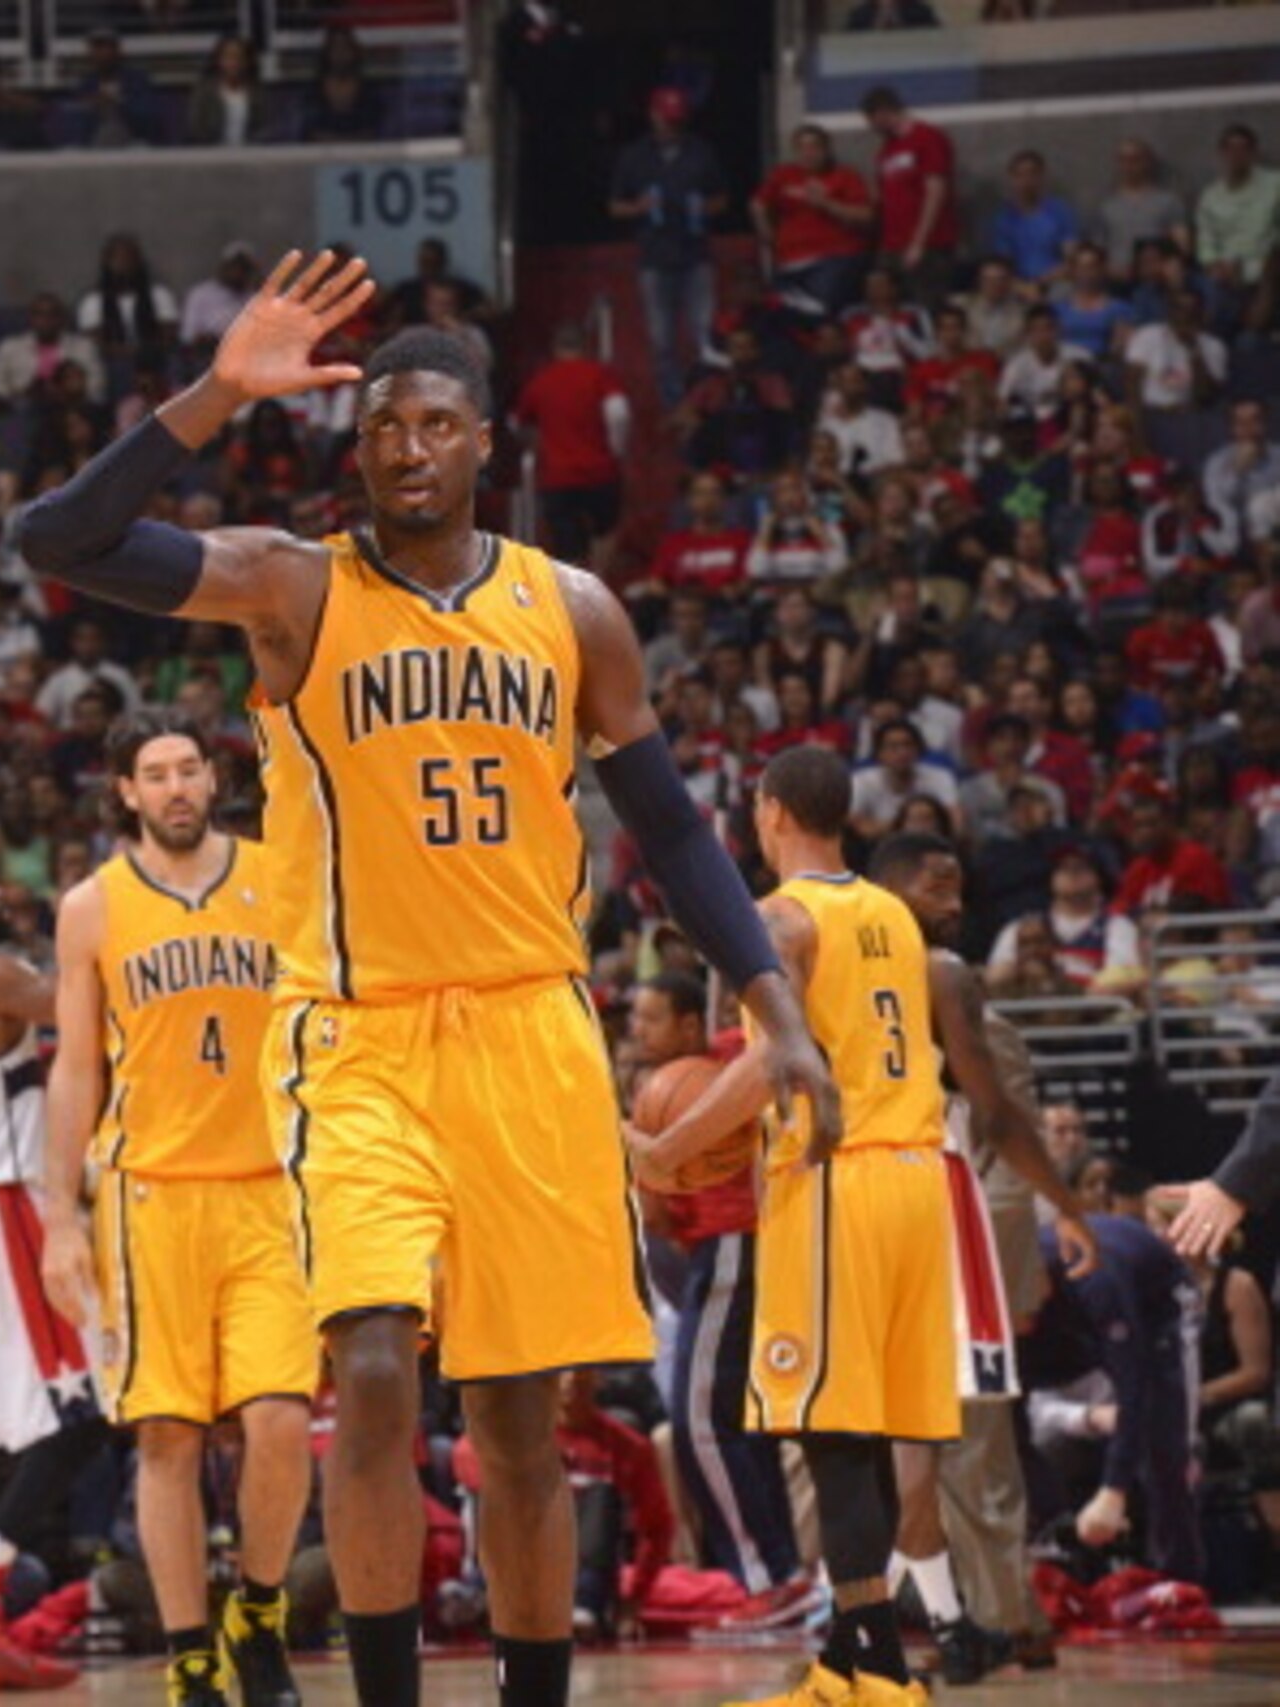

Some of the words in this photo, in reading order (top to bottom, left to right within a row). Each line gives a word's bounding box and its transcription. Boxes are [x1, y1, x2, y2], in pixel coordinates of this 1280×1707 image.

[340, 168, 460, 229] 105
[342, 644, 557, 747] INDIANA
[420, 756, 508, 846] 55
[200, 1015, 225, 1075] 4
[873, 989, 907, 1079] 3
